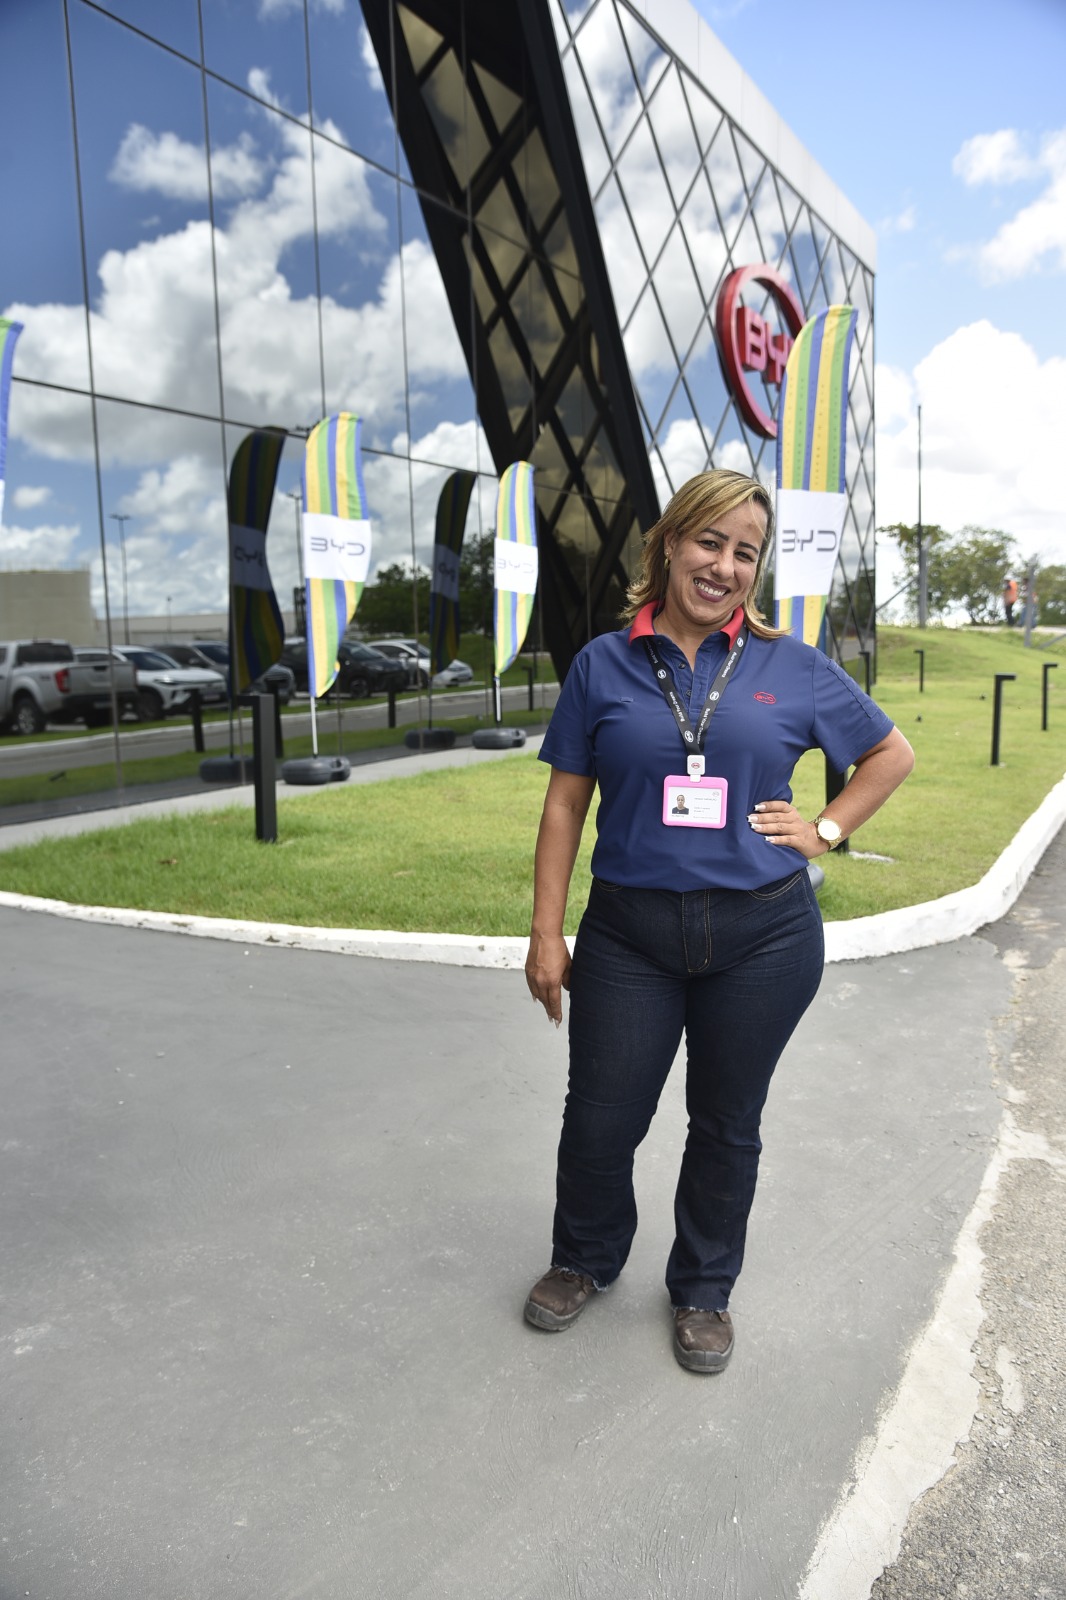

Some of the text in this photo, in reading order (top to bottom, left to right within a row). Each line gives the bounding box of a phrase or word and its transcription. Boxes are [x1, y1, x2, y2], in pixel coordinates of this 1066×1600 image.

[737, 306, 795, 384] BY
[311, 536, 366, 556] BYD
[782, 529, 837, 553] BYD
